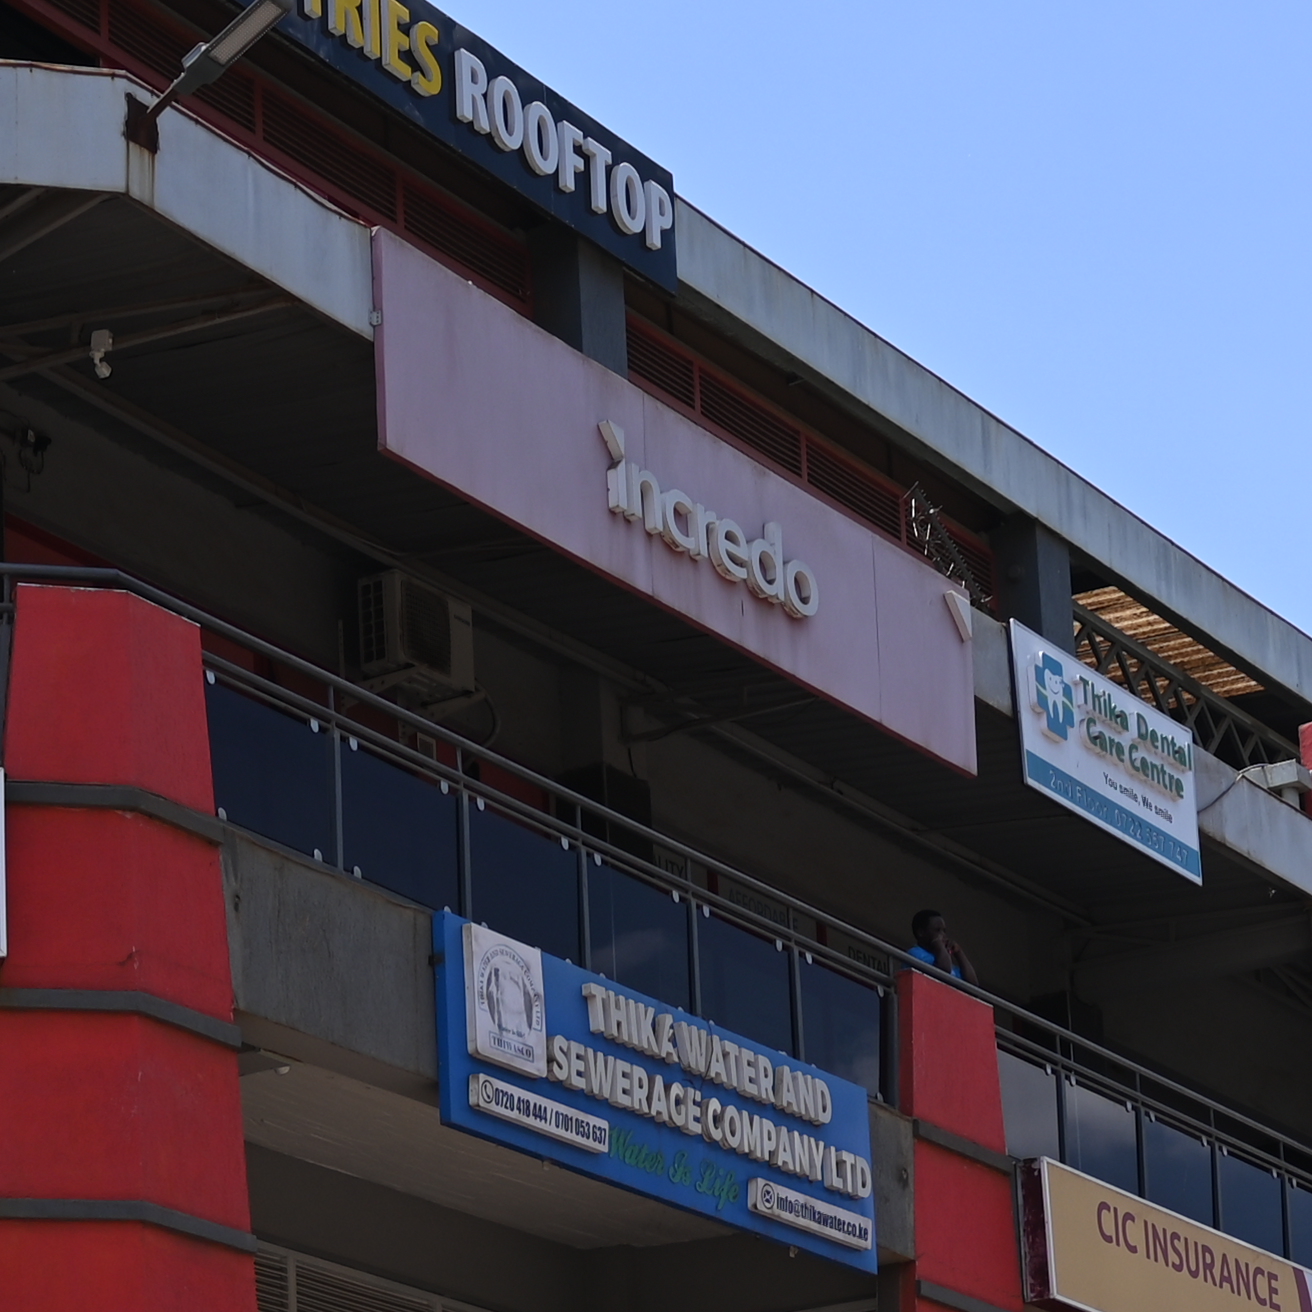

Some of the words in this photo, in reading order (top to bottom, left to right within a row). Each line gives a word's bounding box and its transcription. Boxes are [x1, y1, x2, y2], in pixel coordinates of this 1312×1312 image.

[454, 47, 673, 250] ROOFTOP
[598, 419, 819, 619] incredo
[1075, 675, 1129, 733] Thika
[1134, 711, 1192, 772] Dental
[1084, 715, 1125, 765] Care
[1128, 742, 1185, 802] Centre
[1049, 769, 1074, 800] 2nd
[1076, 785, 1108, 820] Floor
[1114, 809, 1144, 840] 0722
[1103, 771, 1118, 792] You
[1141, 794, 1154, 814] We
[583, 983, 677, 1064] THIKA
[676, 1021, 775, 1104] WATER
[775, 1065, 831, 1126] AND
[494, 1087, 515, 1113] 0720
[516, 1097, 531, 1118] 418
[531, 1104, 548, 1123] 444
[554, 1110, 574, 1135] 0701
[575, 1119, 591, 1141] 053
[592, 1125, 608, 1147] 637
[550, 1036, 702, 1136] SEWERAGE
[703, 1097, 824, 1182] COMPANY
[824, 1146, 872, 1198] LTD
[608, 1127, 666, 1176] Water
[696, 1158, 740, 1211] Life
[776, 1192, 869, 1242] info@thikawater.co.ke
[1096, 1201, 1139, 1255] CIC
[1143, 1219, 1282, 1312] INSURANCE
